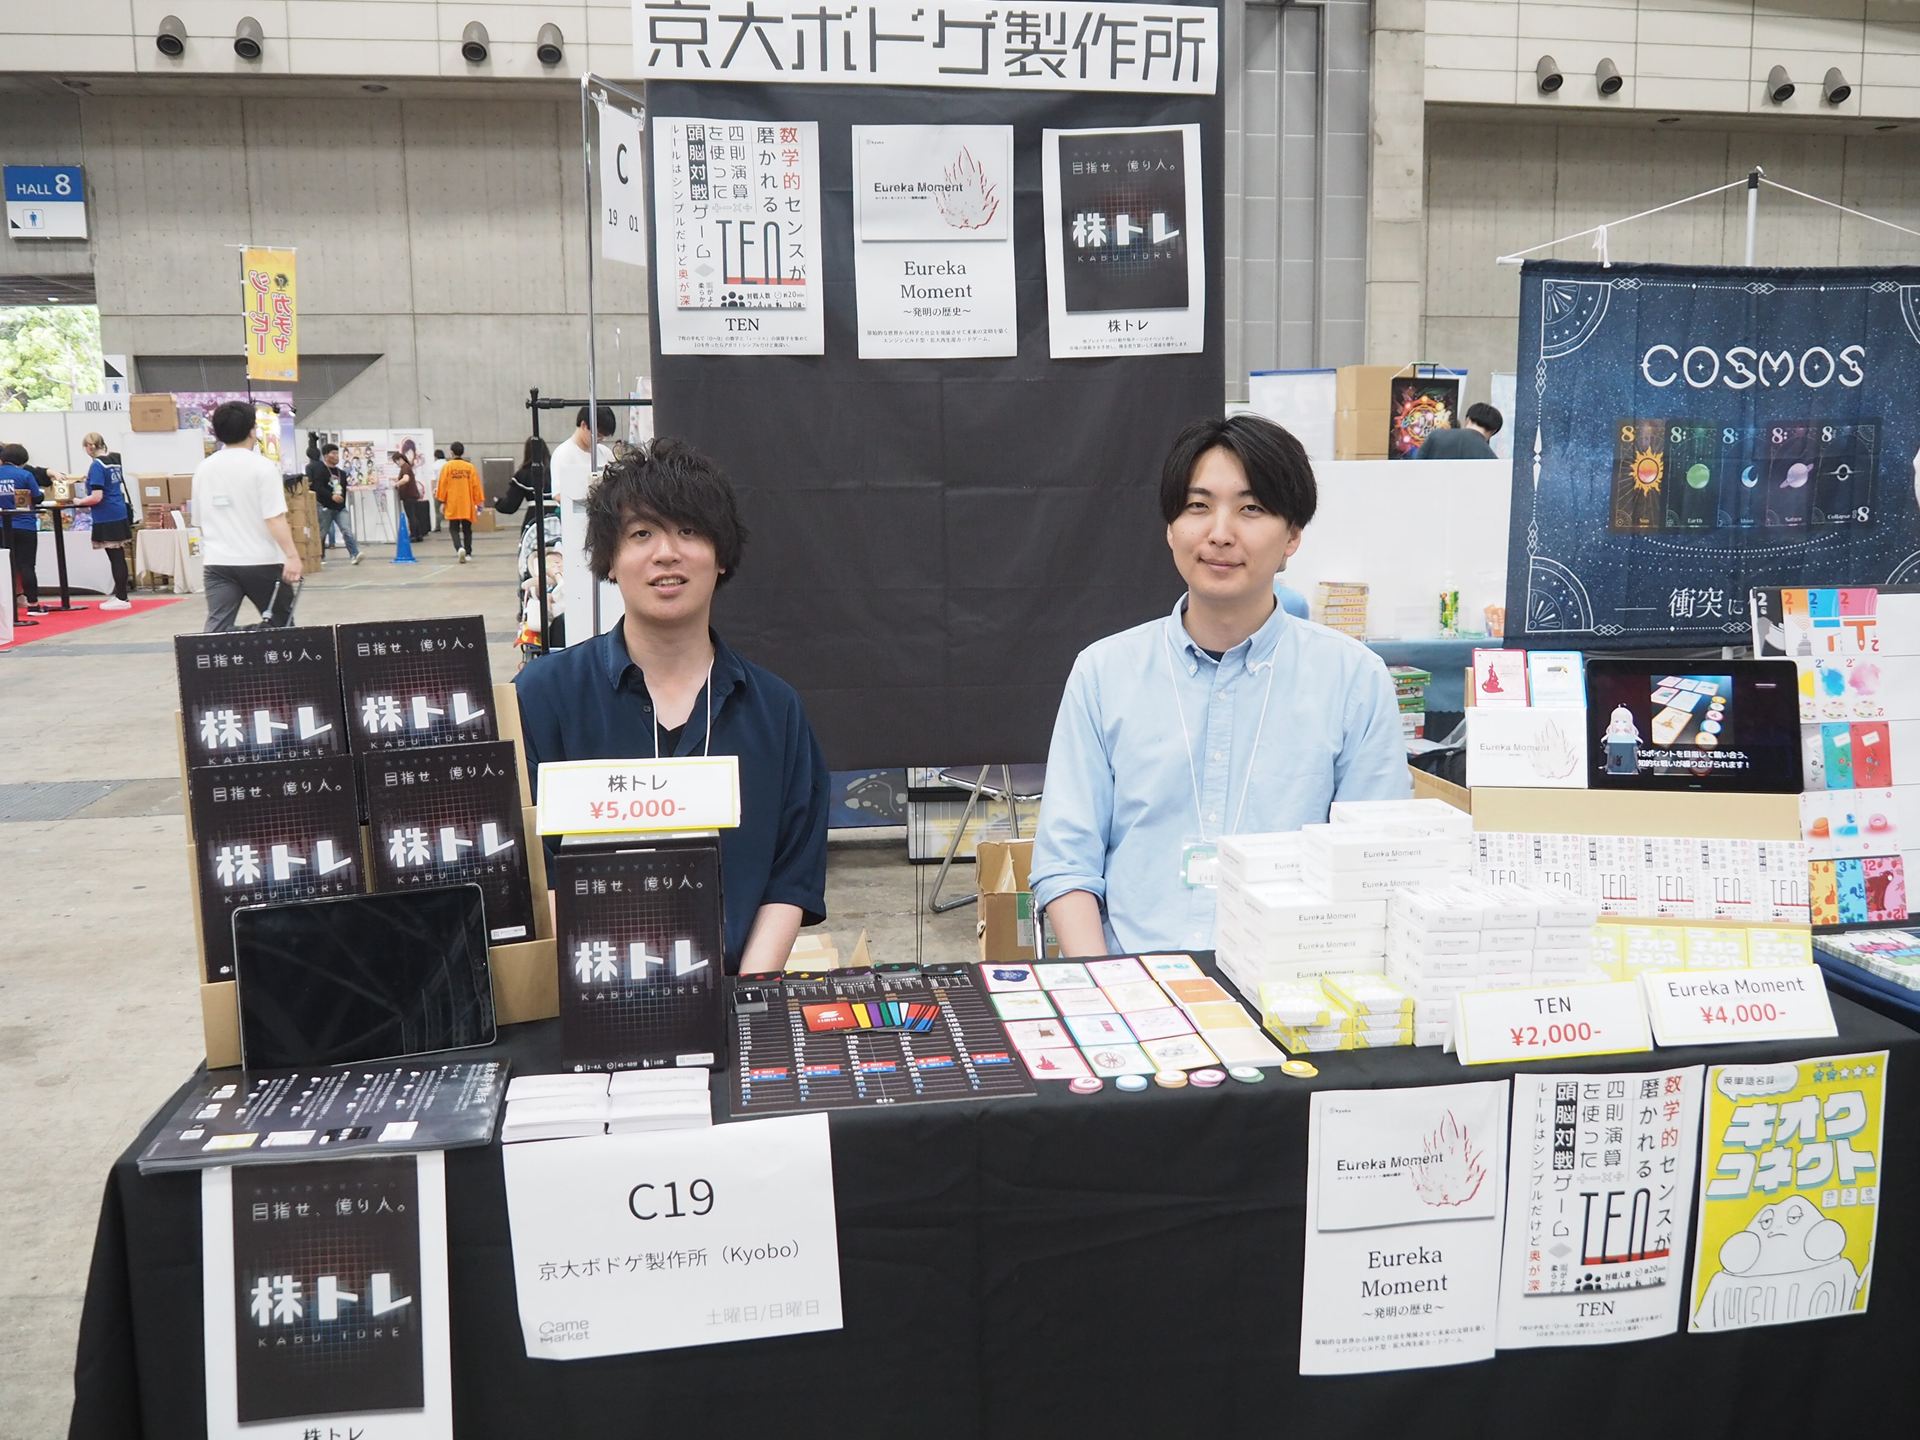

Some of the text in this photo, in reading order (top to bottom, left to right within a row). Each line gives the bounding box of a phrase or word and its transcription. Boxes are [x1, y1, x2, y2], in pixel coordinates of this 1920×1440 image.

[648, 0, 1206, 84] 京大ボドゲ製作所
[616, 143, 629, 185] C
[709, 126, 728, 200] を使った
[728, 126, 749, 200] 四則演算
[757, 127, 779, 214] 磨かれる
[16, 173, 72, 196] HALL 8
[874, 182, 963, 193] Eureka Moment
[779, 127, 807, 282] 数学的センスが
[608, 208, 618, 226] 19
[629, 214, 639, 233] 01
[1072, 212, 1181, 248] 株トレ
[716, 219, 782, 285] TEN
[904, 260, 967, 276] Eureka
[900, 284, 973, 299] Moment
[725, 318, 760, 332] TEN
[1108, 319, 1149, 333] 株トレ
[1639, 344, 1866, 389] COSMOS
[1620, 425, 1636, 443] 8
[1670, 426, 1682, 443] 8
[1722, 427, 1735, 444] 8
[1771, 427, 1784, 444] 8
[1821, 425, 1833, 442] 8
[1857, 506, 1870, 523] 8
[1669, 587, 1750, 619] 衝突に
[1756, 592, 1768, 606] 2
[1784, 592, 1794, 605] 2
[1808, 592, 1818, 605] 2
[1840, 592, 1850, 605] 2
[357, 635, 475, 657] 目指せ、億り人。
[196, 650, 322, 669] 目指せ、億り人。
[361, 692, 485, 734] 株トレ
[199, 706, 333, 750] 株トレ
[1480, 743, 1511, 751] Eureka
[384, 763, 505, 787] 目指せ、億り人。
[607, 774, 669, 793] 株トレ
[213, 778, 343, 803] 目指せ、億り人。
[589, 798, 687, 822] ¥5,000-
[389, 822, 515, 869] 株トレ
[1363, 849, 1421, 859] Eureka Moment
[215, 839, 352, 887] 株トレ
[1811, 862, 1820, 873] 4
[1839, 861, 1847, 872] 3
[1863, 860, 1876, 871] 12
[575, 872, 704, 895] 目指せ、億り人。
[1362, 881, 1389, 889] Eureka
[1298, 912, 1357, 922] Eureka Moment
[1298, 942, 1325, 950] Eureka
[574, 939, 710, 984] 株トレ
[1667, 977, 1806, 998] Eureka Moment
[1534, 996, 1572, 1015] TEN
[1699, 1002, 1787, 1026] ¥4,000-
[1509, 1022, 1603, 1048] ¥2,000-
[1580, 1082, 1600, 1169] を使った
[1603, 1080, 1625, 1168] 四則演算
[1636, 1078, 1660, 1179] 磨かれる
[1723, 1090, 1868, 1152] キオク
[1336, 1152, 1444, 1172] Eureka Moment
[1654, 1075, 1683, 1252] 数学的センスが
[1706, 1138, 1876, 1199] コネクト
[252, 1195, 407, 1222] 目指せ、億り人。
[628, 1178, 715, 1221] C19
[1580, 1187, 1651, 1266] TEN
[1367, 1245, 1443, 1270] Eureka
[1361, 1273, 1448, 1299] Moment
[251, 1271, 413, 1327] 株トレ
[1576, 1301, 1616, 1317] TEN
[706, 1299, 821, 1327] 土曜日/日曜日
[539, 1319, 590, 1335] Game
[540, 1331, 590, 1344] Market
